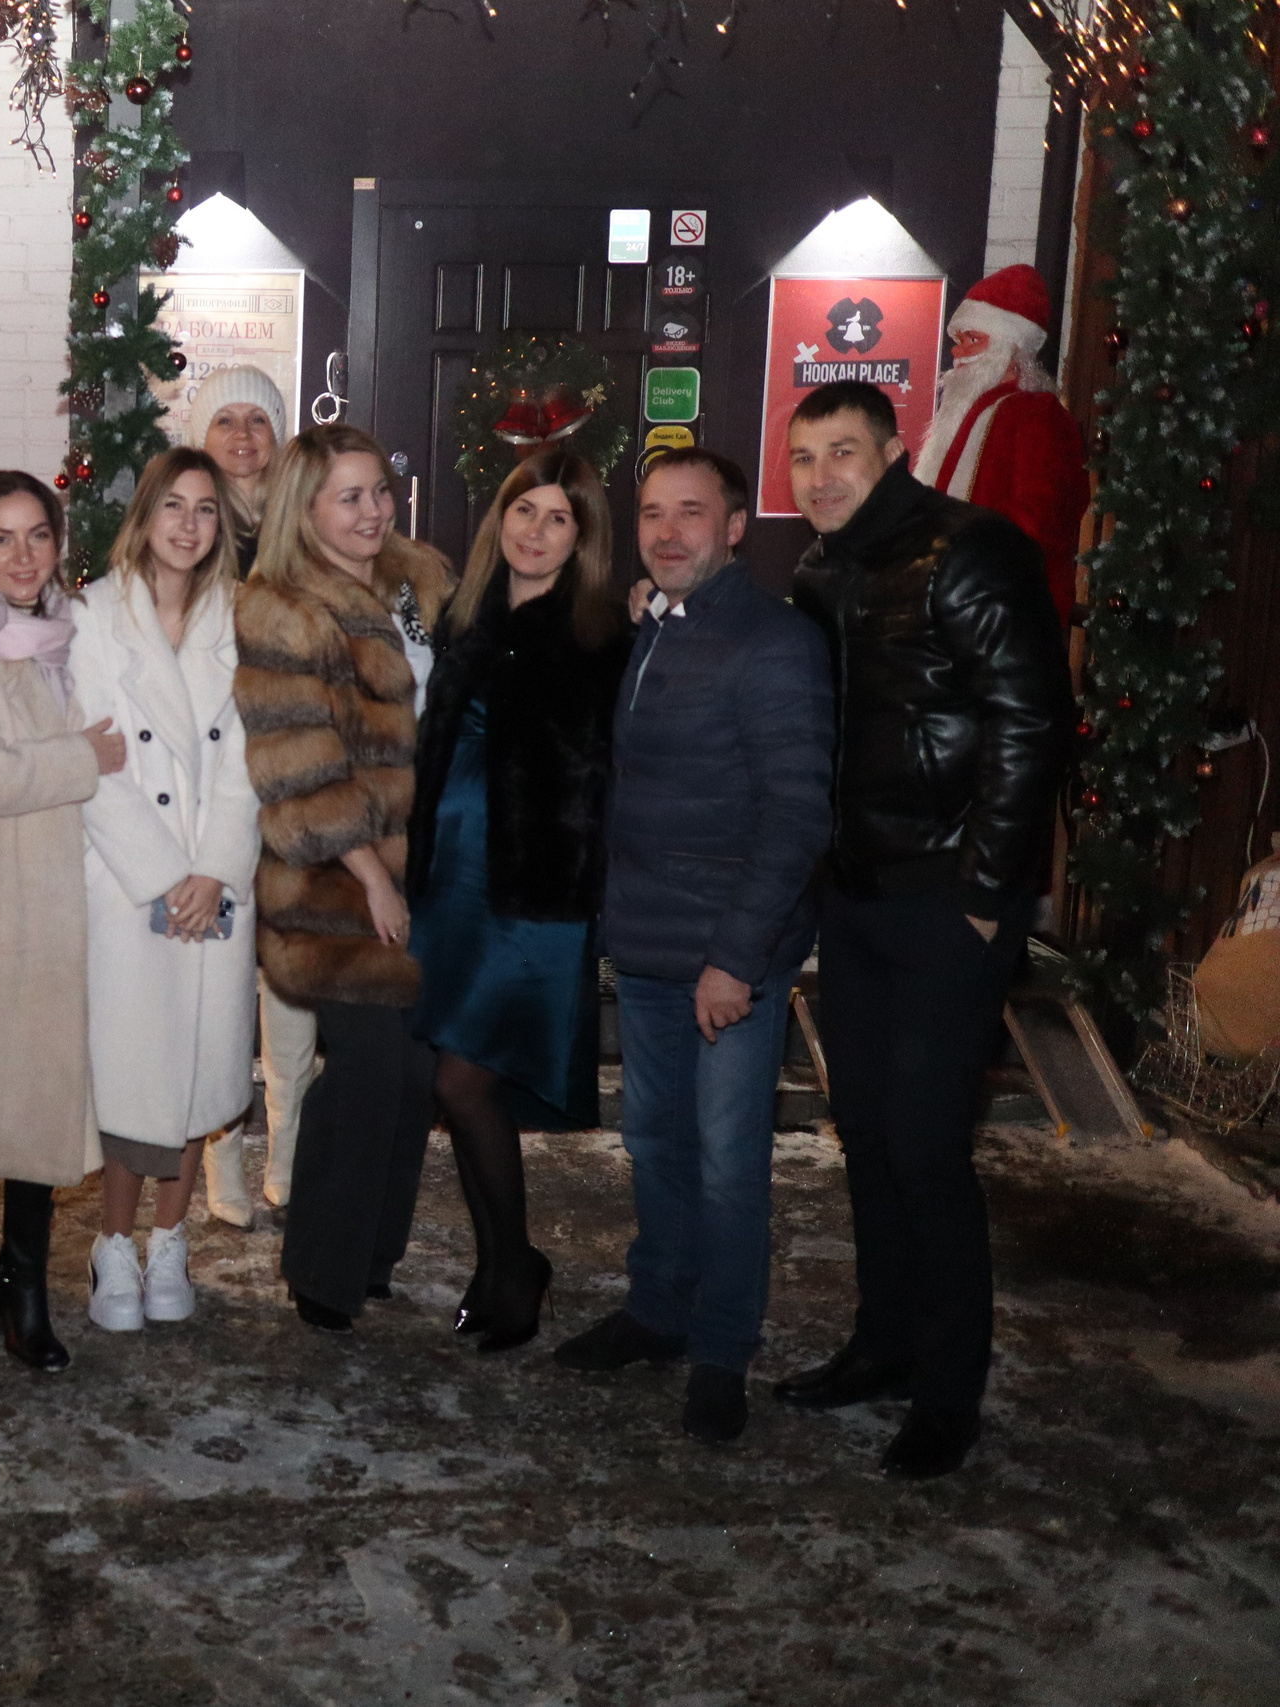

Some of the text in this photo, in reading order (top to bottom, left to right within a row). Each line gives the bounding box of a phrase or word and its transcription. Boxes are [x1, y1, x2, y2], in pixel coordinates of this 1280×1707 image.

[625, 242, 645, 251] 24/7
[666, 265, 696, 287] 18+
[186, 298, 247, 308] ТИПОГРАФИЯ
[160, 320, 275, 340] РАБОТАЕМ
[802, 363, 900, 383] HOOKAH PLACE
[652, 387, 692, 397] Delivery
[652, 397, 675, 405] Club
[653, 432, 687, 440] Яндекс Еда
